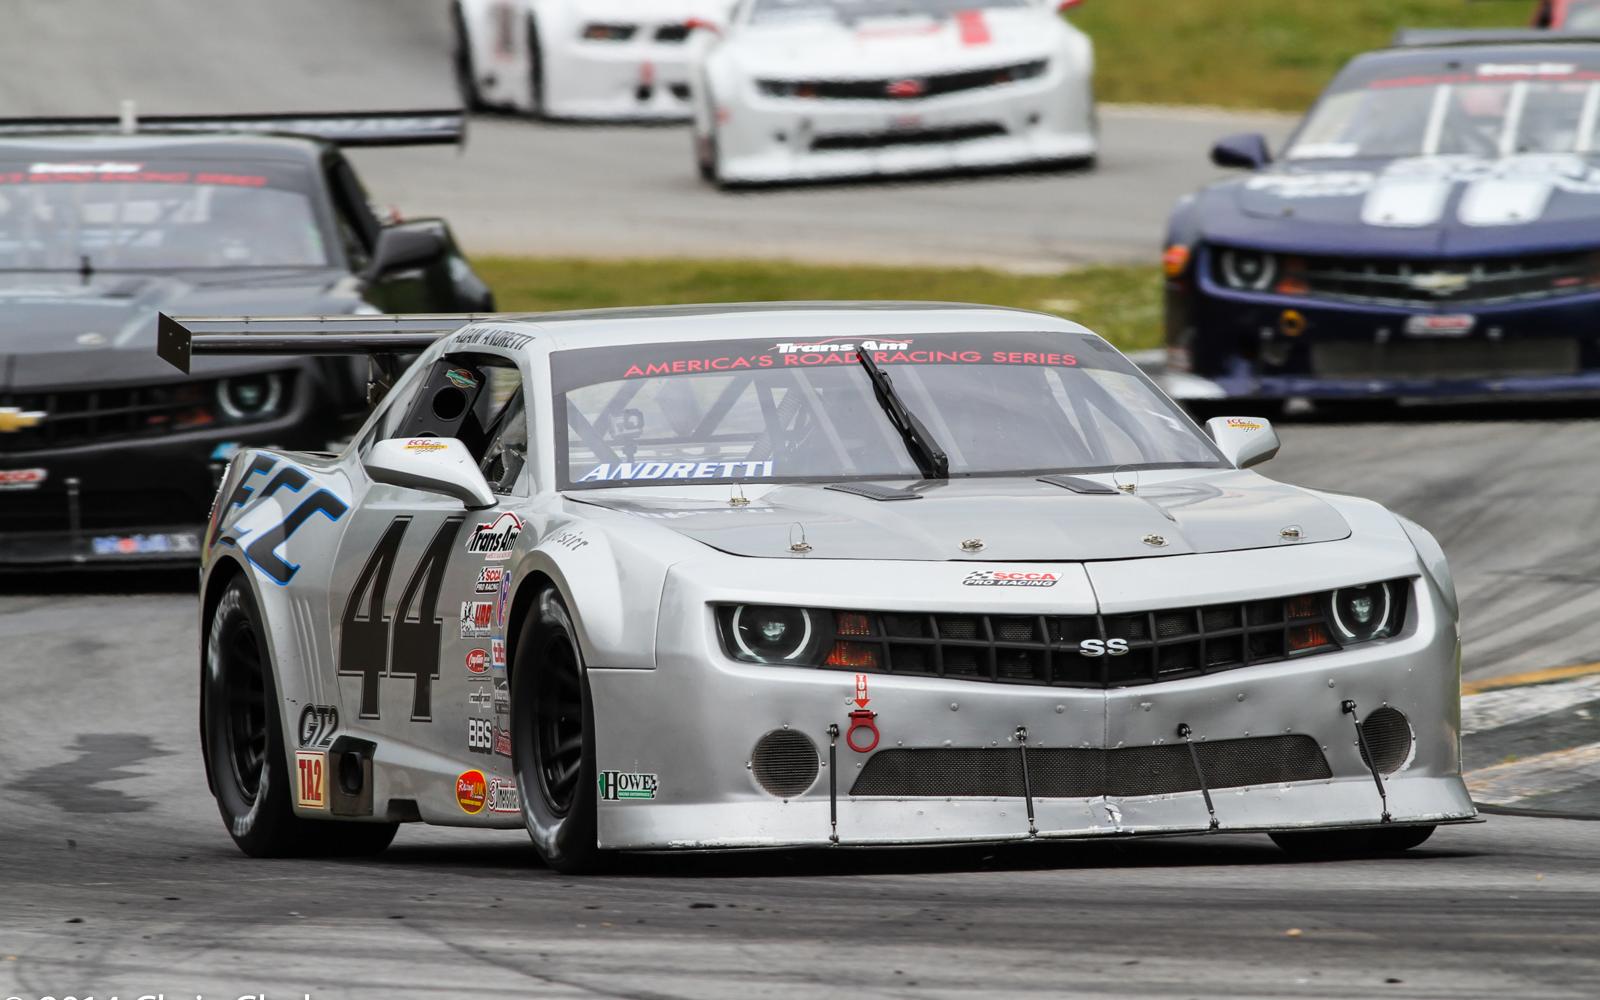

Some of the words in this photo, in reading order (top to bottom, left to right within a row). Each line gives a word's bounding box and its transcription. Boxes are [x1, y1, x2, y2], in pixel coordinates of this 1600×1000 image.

[776, 343, 854, 354] Trans
[858, 340, 908, 351] Am
[623, 354, 773, 378] AMERICA'S
[784, 353, 861, 367] ROAD
[875, 350, 982, 363] RACING
[993, 351, 1077, 366] SERIES
[579, 460, 773, 482] ANDRETTI
[994, 572, 1058, 580] SCCA
[1001, 579, 1055, 587] RACING
[338, 515, 466, 722] 44
[1080, 638, 1129, 657] SS
[857, 675, 867, 699] TOW
[298, 703, 339, 748] GT2
[469, 718, 491, 751] BBS
[299, 759, 321, 800] TA2
[602, 771, 652, 800] HOWE
